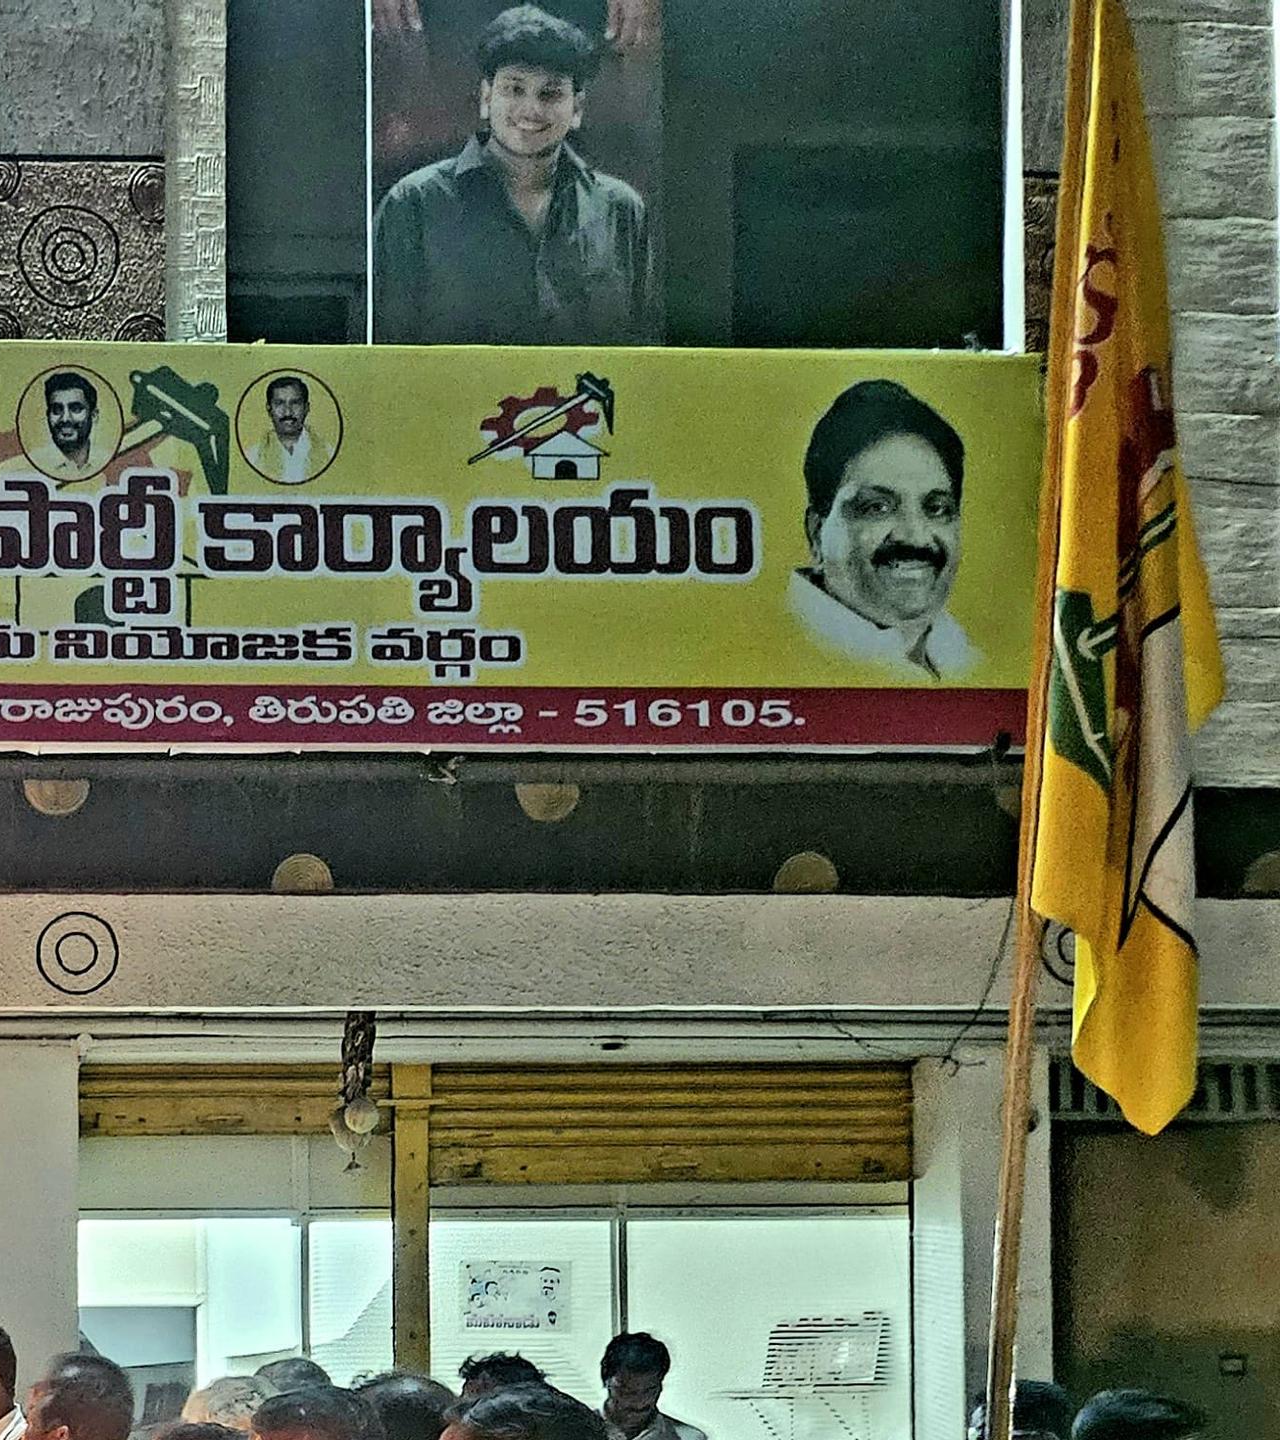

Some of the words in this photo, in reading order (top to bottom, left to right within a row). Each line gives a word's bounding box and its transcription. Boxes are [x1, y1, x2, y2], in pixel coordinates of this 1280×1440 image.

[196, 485, 756, 614] కార్యాలయం
[52, 623, 352, 661] నియోజక
[370, 626, 522, 679] వర్గం
[248, 694, 416, 727] తిరుపతి
[426, 696, 525, 735] జిల్లా
[572, 698, 807, 728] 516105.
